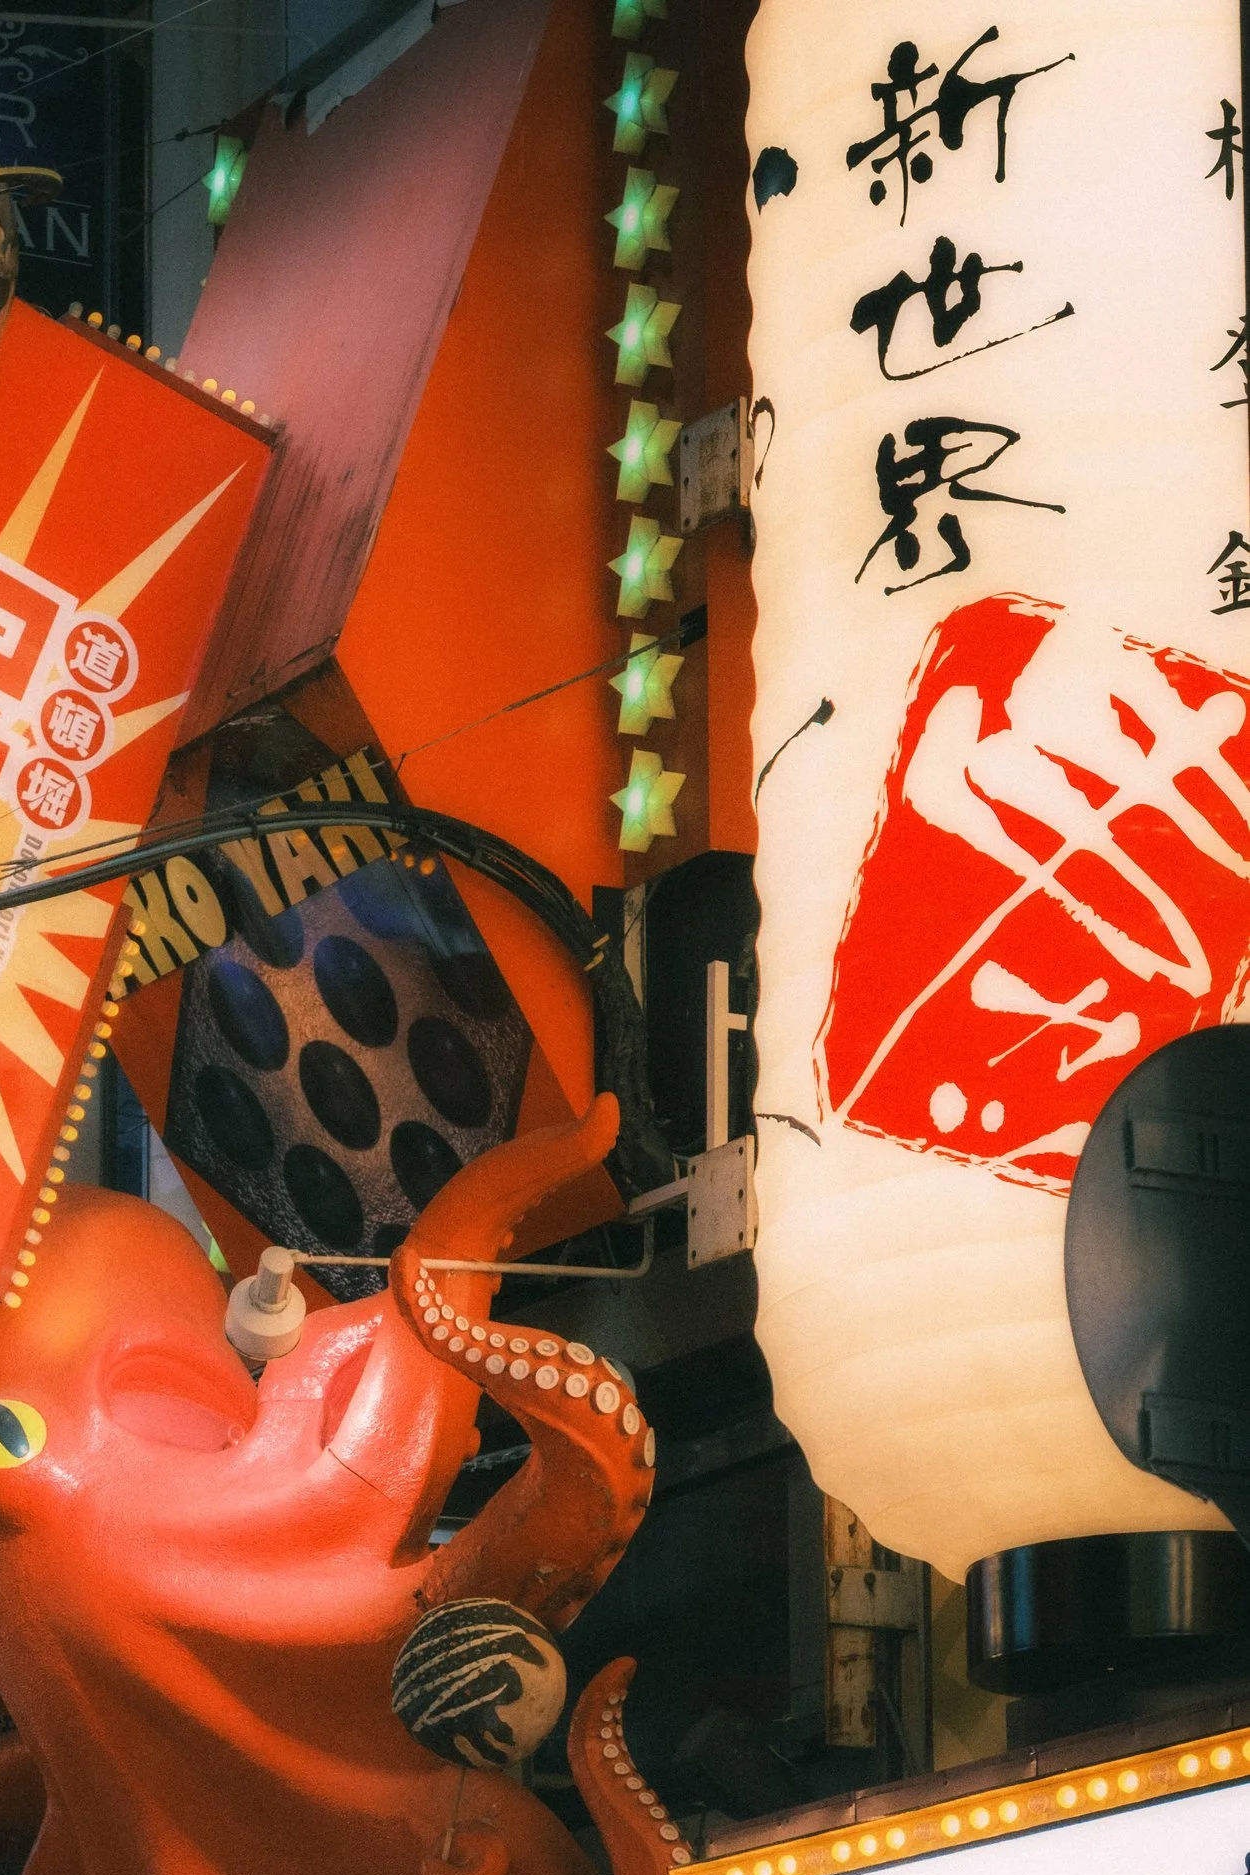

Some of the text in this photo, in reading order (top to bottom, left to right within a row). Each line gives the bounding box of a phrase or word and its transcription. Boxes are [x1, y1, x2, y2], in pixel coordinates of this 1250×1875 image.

[846, 25, 1076, 596] 新世界
[22, 625, 128, 830] 道頓堀
